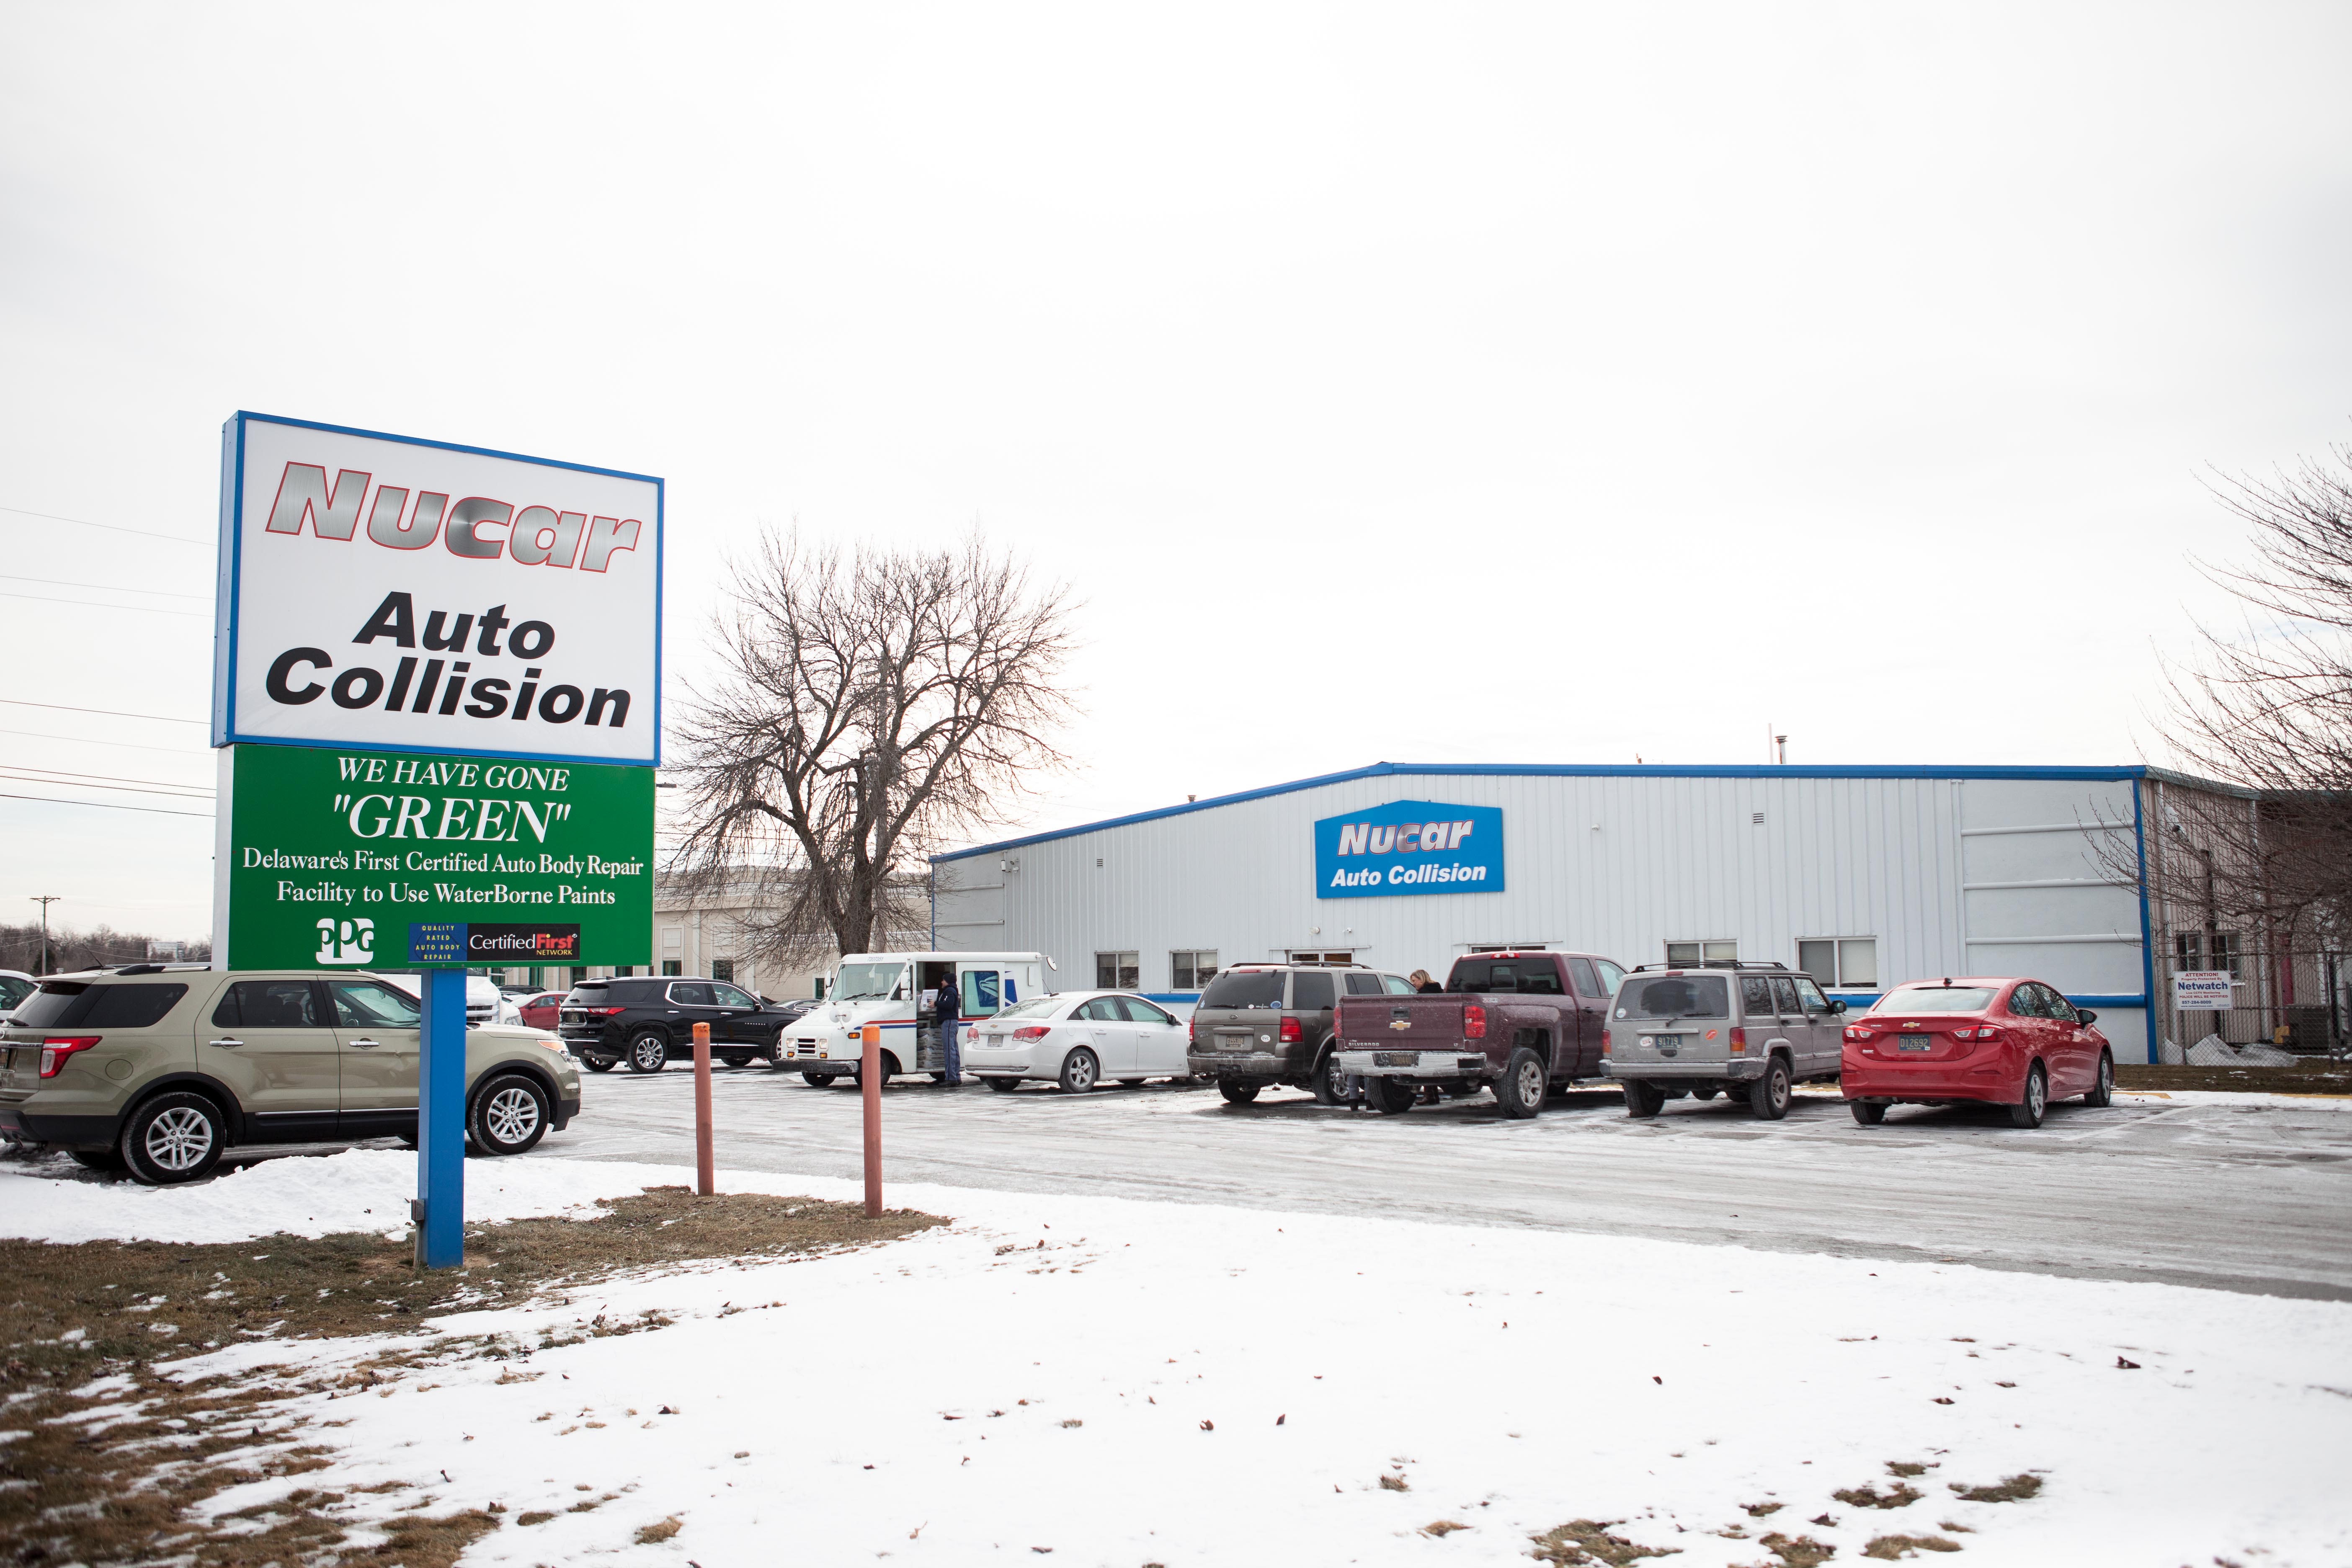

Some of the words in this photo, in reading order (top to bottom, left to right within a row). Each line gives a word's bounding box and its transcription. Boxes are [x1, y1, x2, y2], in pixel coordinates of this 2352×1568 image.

[265, 461, 642, 574] Nucar
[352, 591, 555, 660] Auto
[266, 647, 631, 728] Collision
[338, 757, 387, 782] WE
[391, 760, 480, 787] HAVE
[484, 765, 570, 791] GONE
[1337, 820, 1474, 856] Nucar
[242, 847, 349, 870] Delaware's
[354, 850, 400, 871] First
[405, 851, 488, 872] Certified
[491, 853, 536, 873] Auto
[539, 854, 585, 879] Body
[587, 855, 644, 879] Repair
[1330, 868, 1381, 887] Auto
[1388, 862, 1487, 885] Collision
[277, 881, 356, 906] Facility
[363, 885, 384, 902] to
[389, 882, 429, 903] Use
[434, 883, 554, 904] WaterBorne
[557, 885, 616, 905] Paints
[2178, 981, 2228, 990] Netwatch
[1658, 1037, 1678, 1046] 91719
[1900, 1038, 1928, 1047] D12692
